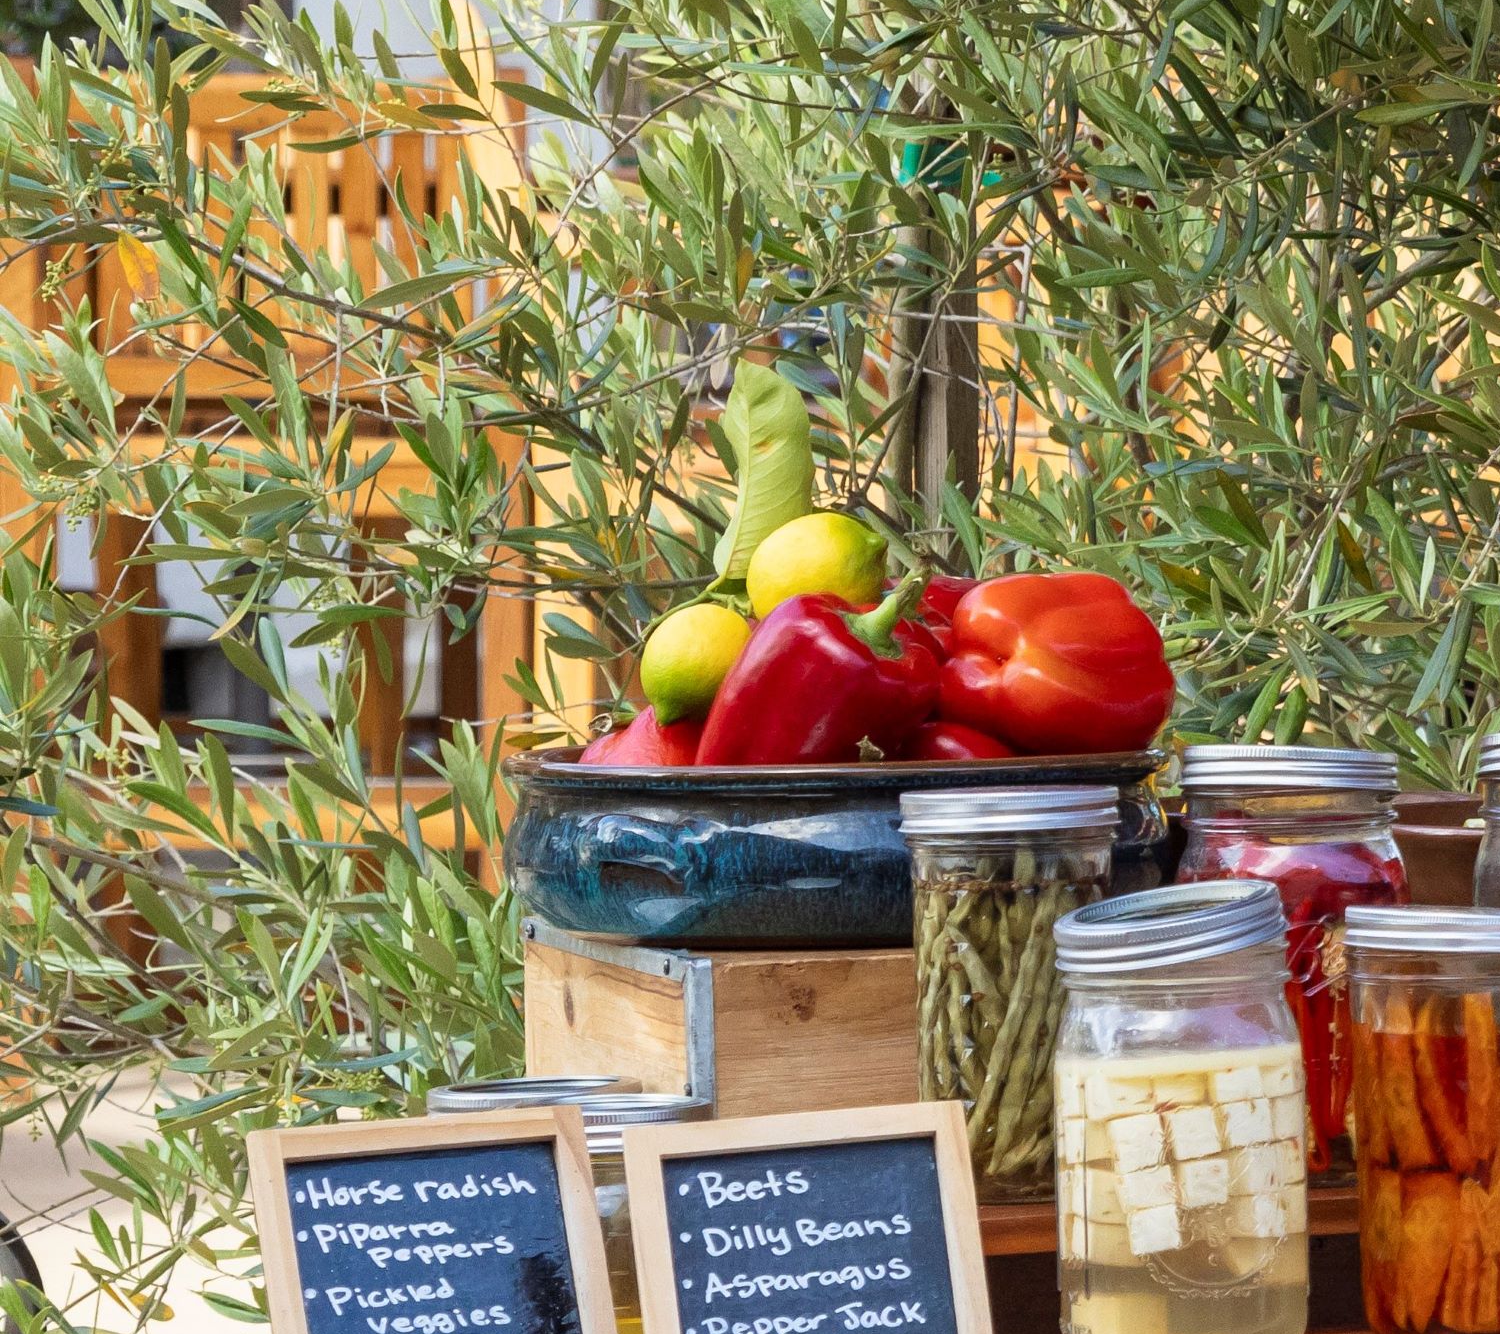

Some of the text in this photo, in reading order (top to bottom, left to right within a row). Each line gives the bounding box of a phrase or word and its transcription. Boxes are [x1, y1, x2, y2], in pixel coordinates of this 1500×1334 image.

[306, 1172, 536, 1209] Horse radish
[697, 1170, 809, 1209] Beets
[367, 1235, 514, 1268] Peppers
[702, 1215, 911, 1257] Dilly Beans
[326, 1278, 454, 1316] Pickled
[705, 1257, 911, 1303] Asparagus
[367, 1305, 511, 1334] veggies
[835, 1301, 926, 1331] Jack
